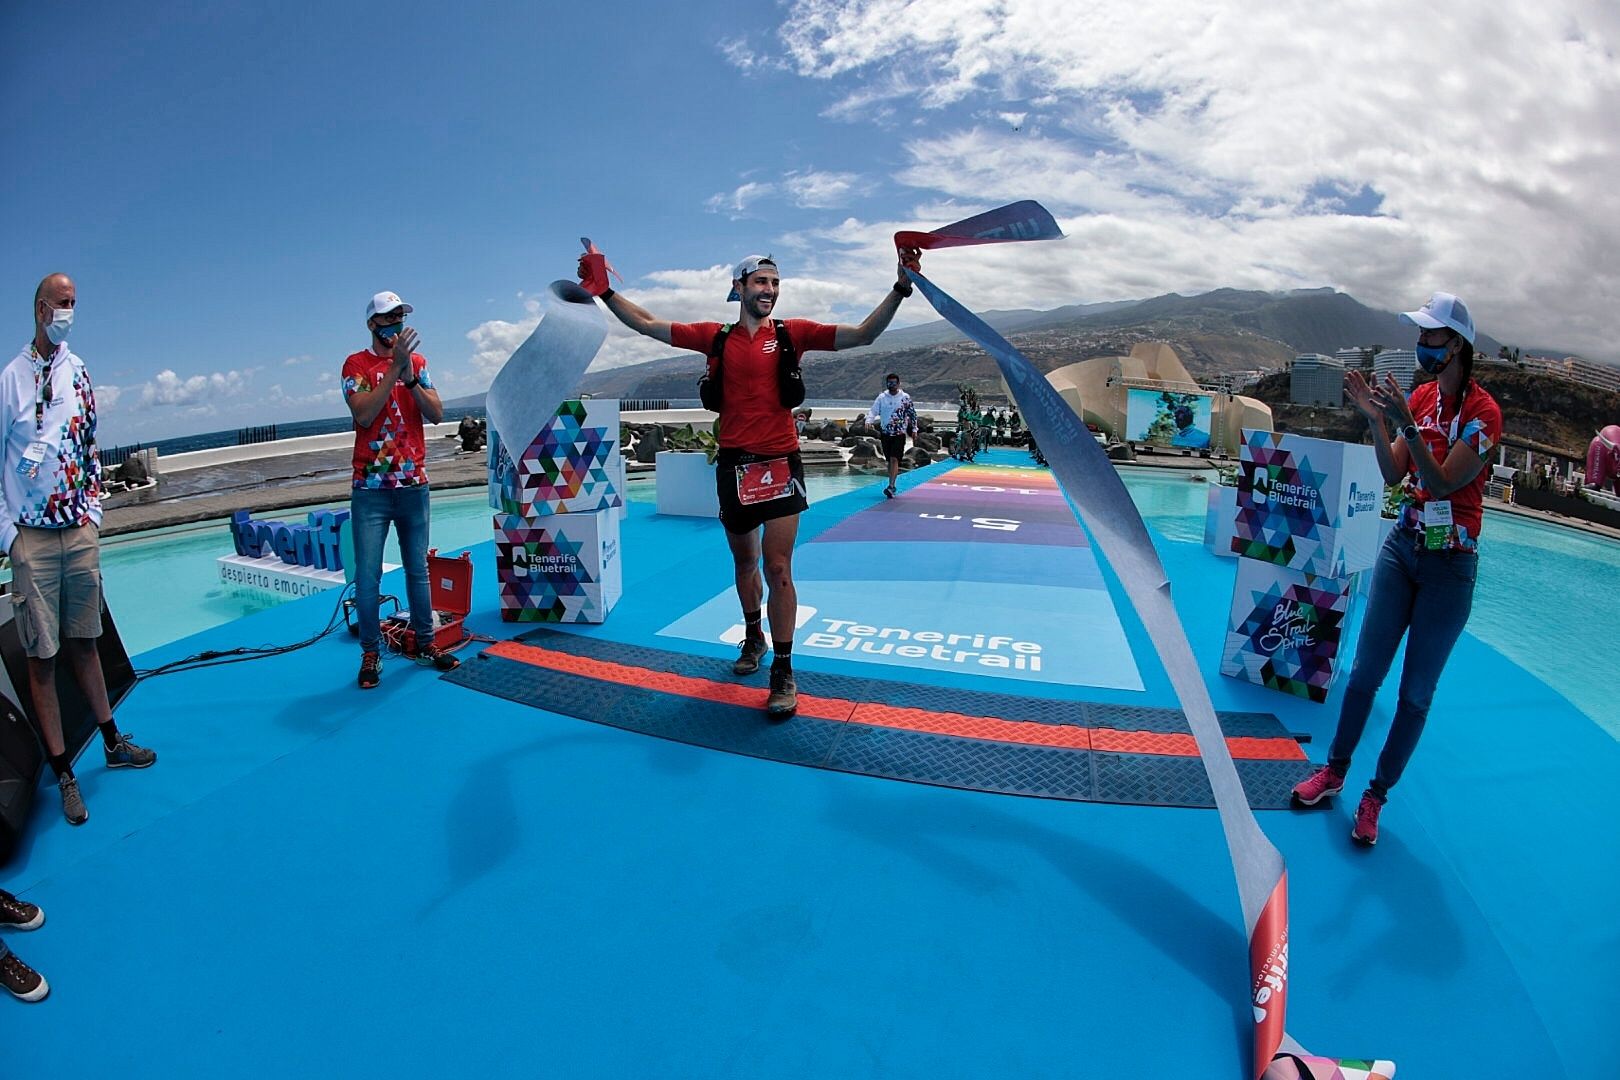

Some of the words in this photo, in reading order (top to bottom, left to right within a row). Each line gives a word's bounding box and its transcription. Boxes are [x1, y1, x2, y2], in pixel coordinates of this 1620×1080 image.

[760, 470, 774, 485] 4
[1269, 478, 1318, 498] Tenerife
[1268, 491, 1317, 511] Bluetrail
[971, 517, 1022, 532] 5
[229, 508, 357, 584] tenerif
[528, 553, 577, 564] Tenerife
[529, 564, 577, 573] Bluetrail
[221, 564, 269, 588] despierta
[1272, 600, 1304, 625] Blue
[821, 618, 1042, 654] Tenerife
[1280, 614, 1316, 637] Trail
[802, 632, 1042, 672] Bluetrail
[1260, 627, 1316, 656] Spirit
